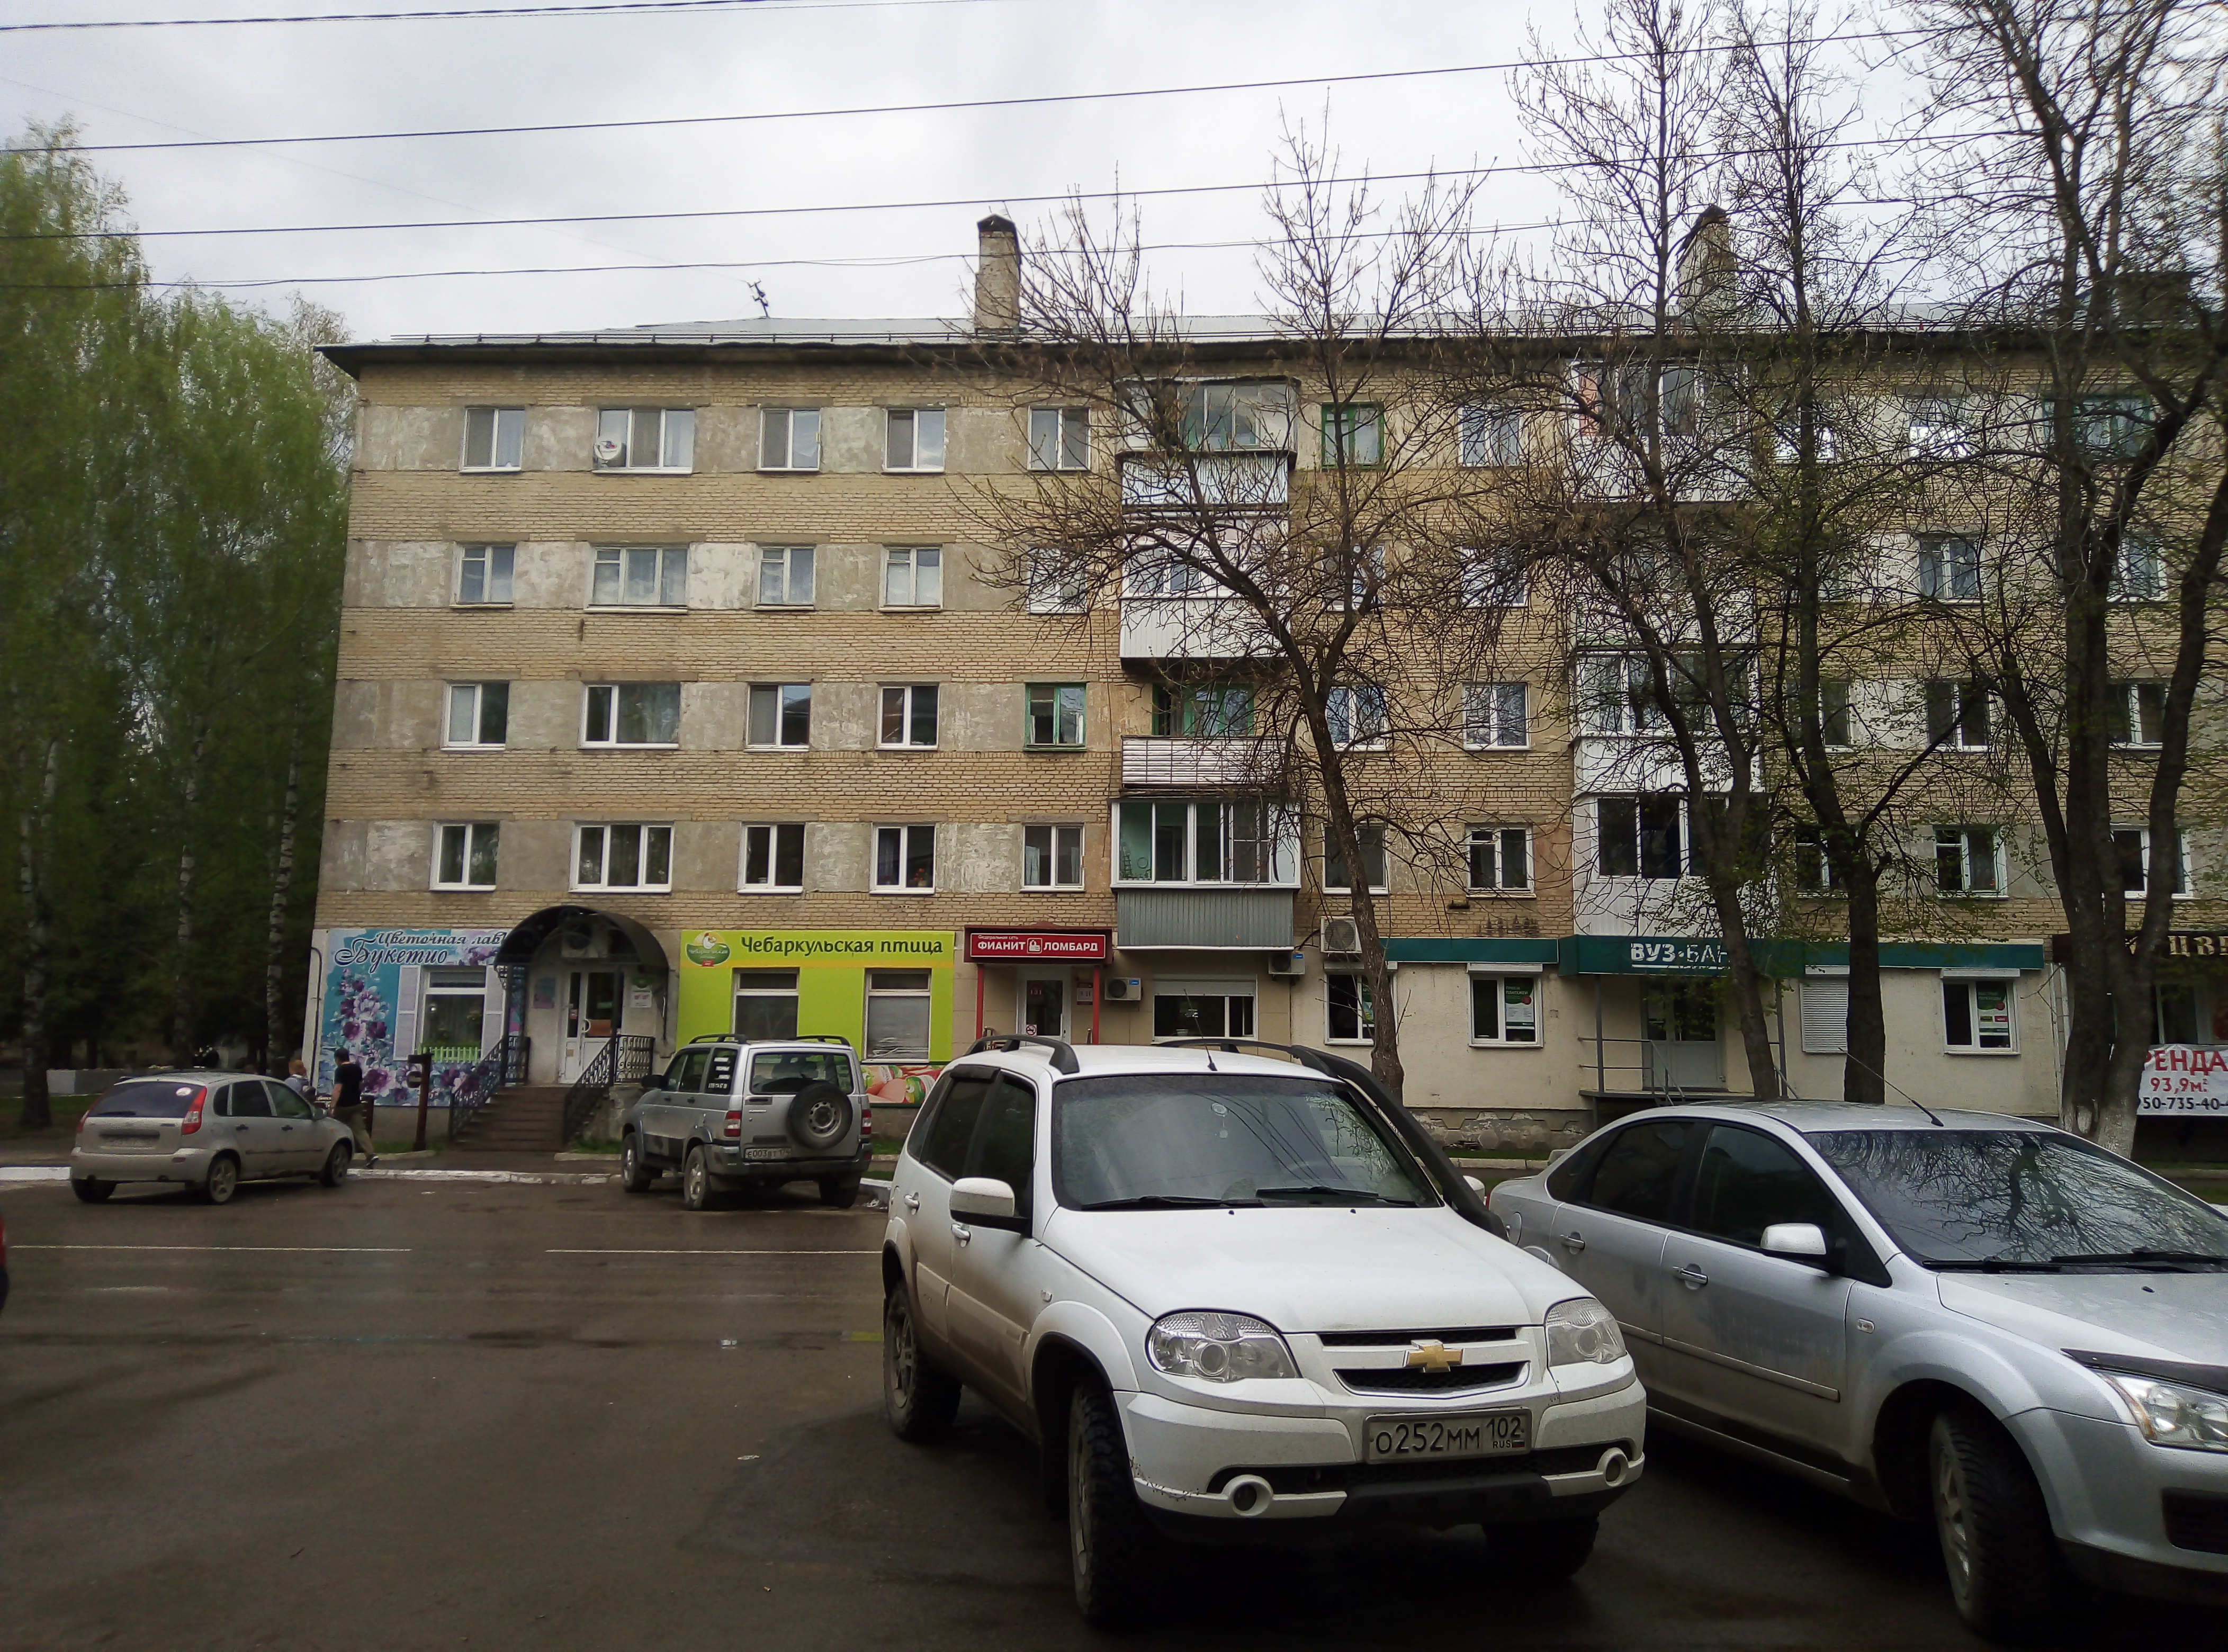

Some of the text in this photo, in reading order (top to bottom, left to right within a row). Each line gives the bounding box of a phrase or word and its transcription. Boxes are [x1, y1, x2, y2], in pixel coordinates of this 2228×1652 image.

[375, 931, 507, 947] Цветочная лав
[741, 936, 943, 956] Чебаркульская птица
[977, 941, 1098, 951] ФИАНИТ ЛОМБАРД
[1486, 1416, 1522, 1439] 102
[1493, 1440, 1511, 1449] RUS
